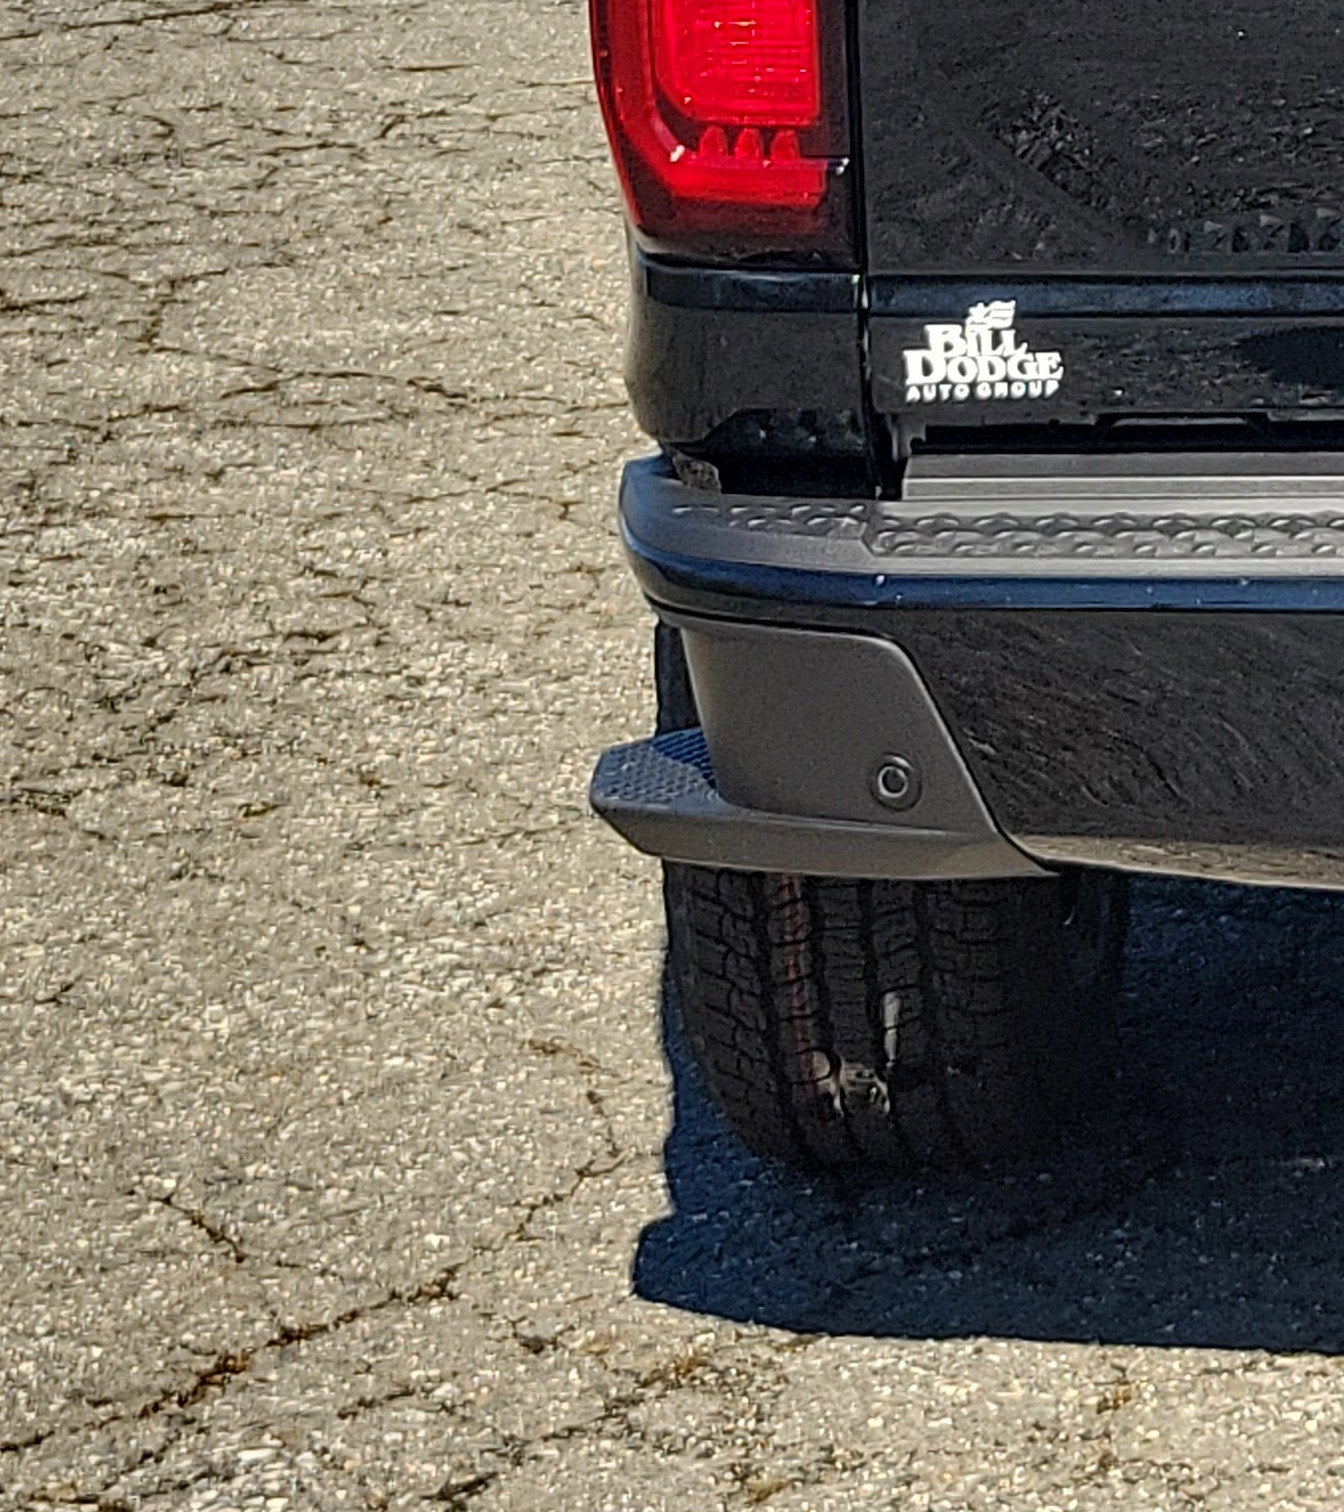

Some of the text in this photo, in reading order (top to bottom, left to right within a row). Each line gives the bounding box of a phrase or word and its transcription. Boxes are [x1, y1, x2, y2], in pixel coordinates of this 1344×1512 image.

[924, 324, 1028, 358] BILL
[903, 349, 1064, 385] DODGE
[906, 380, 1060, 403] AUTO GROUP
